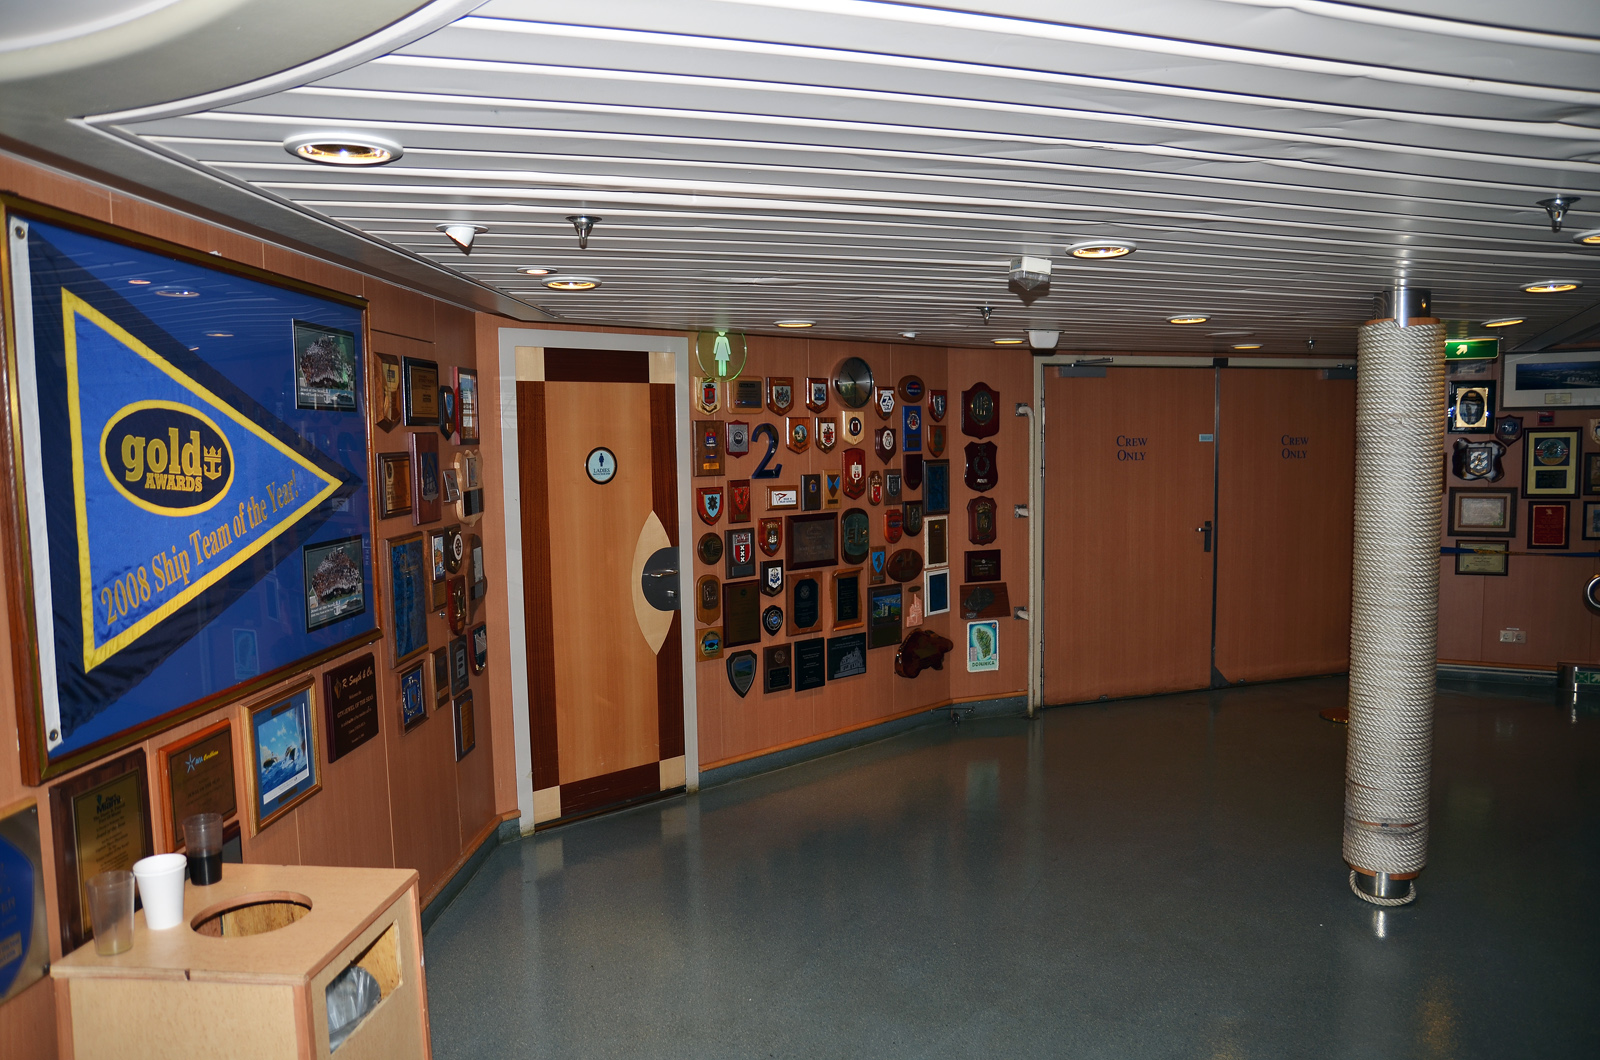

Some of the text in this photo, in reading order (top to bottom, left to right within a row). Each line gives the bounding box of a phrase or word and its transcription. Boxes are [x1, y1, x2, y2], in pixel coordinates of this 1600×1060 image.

[1116, 435, 1148, 447] CREW
[1281, 434, 1309, 446] CREW
[122, 427, 202, 482] gold
[751, 423, 782, 479] 2
[1117, 449, 1147, 461] ONLY
[1282, 448, 1307, 460] ONLY
[144, 472, 202, 492] AWARDS
[101, 469, 300, 625] 2008 Ship Team of the Year!
